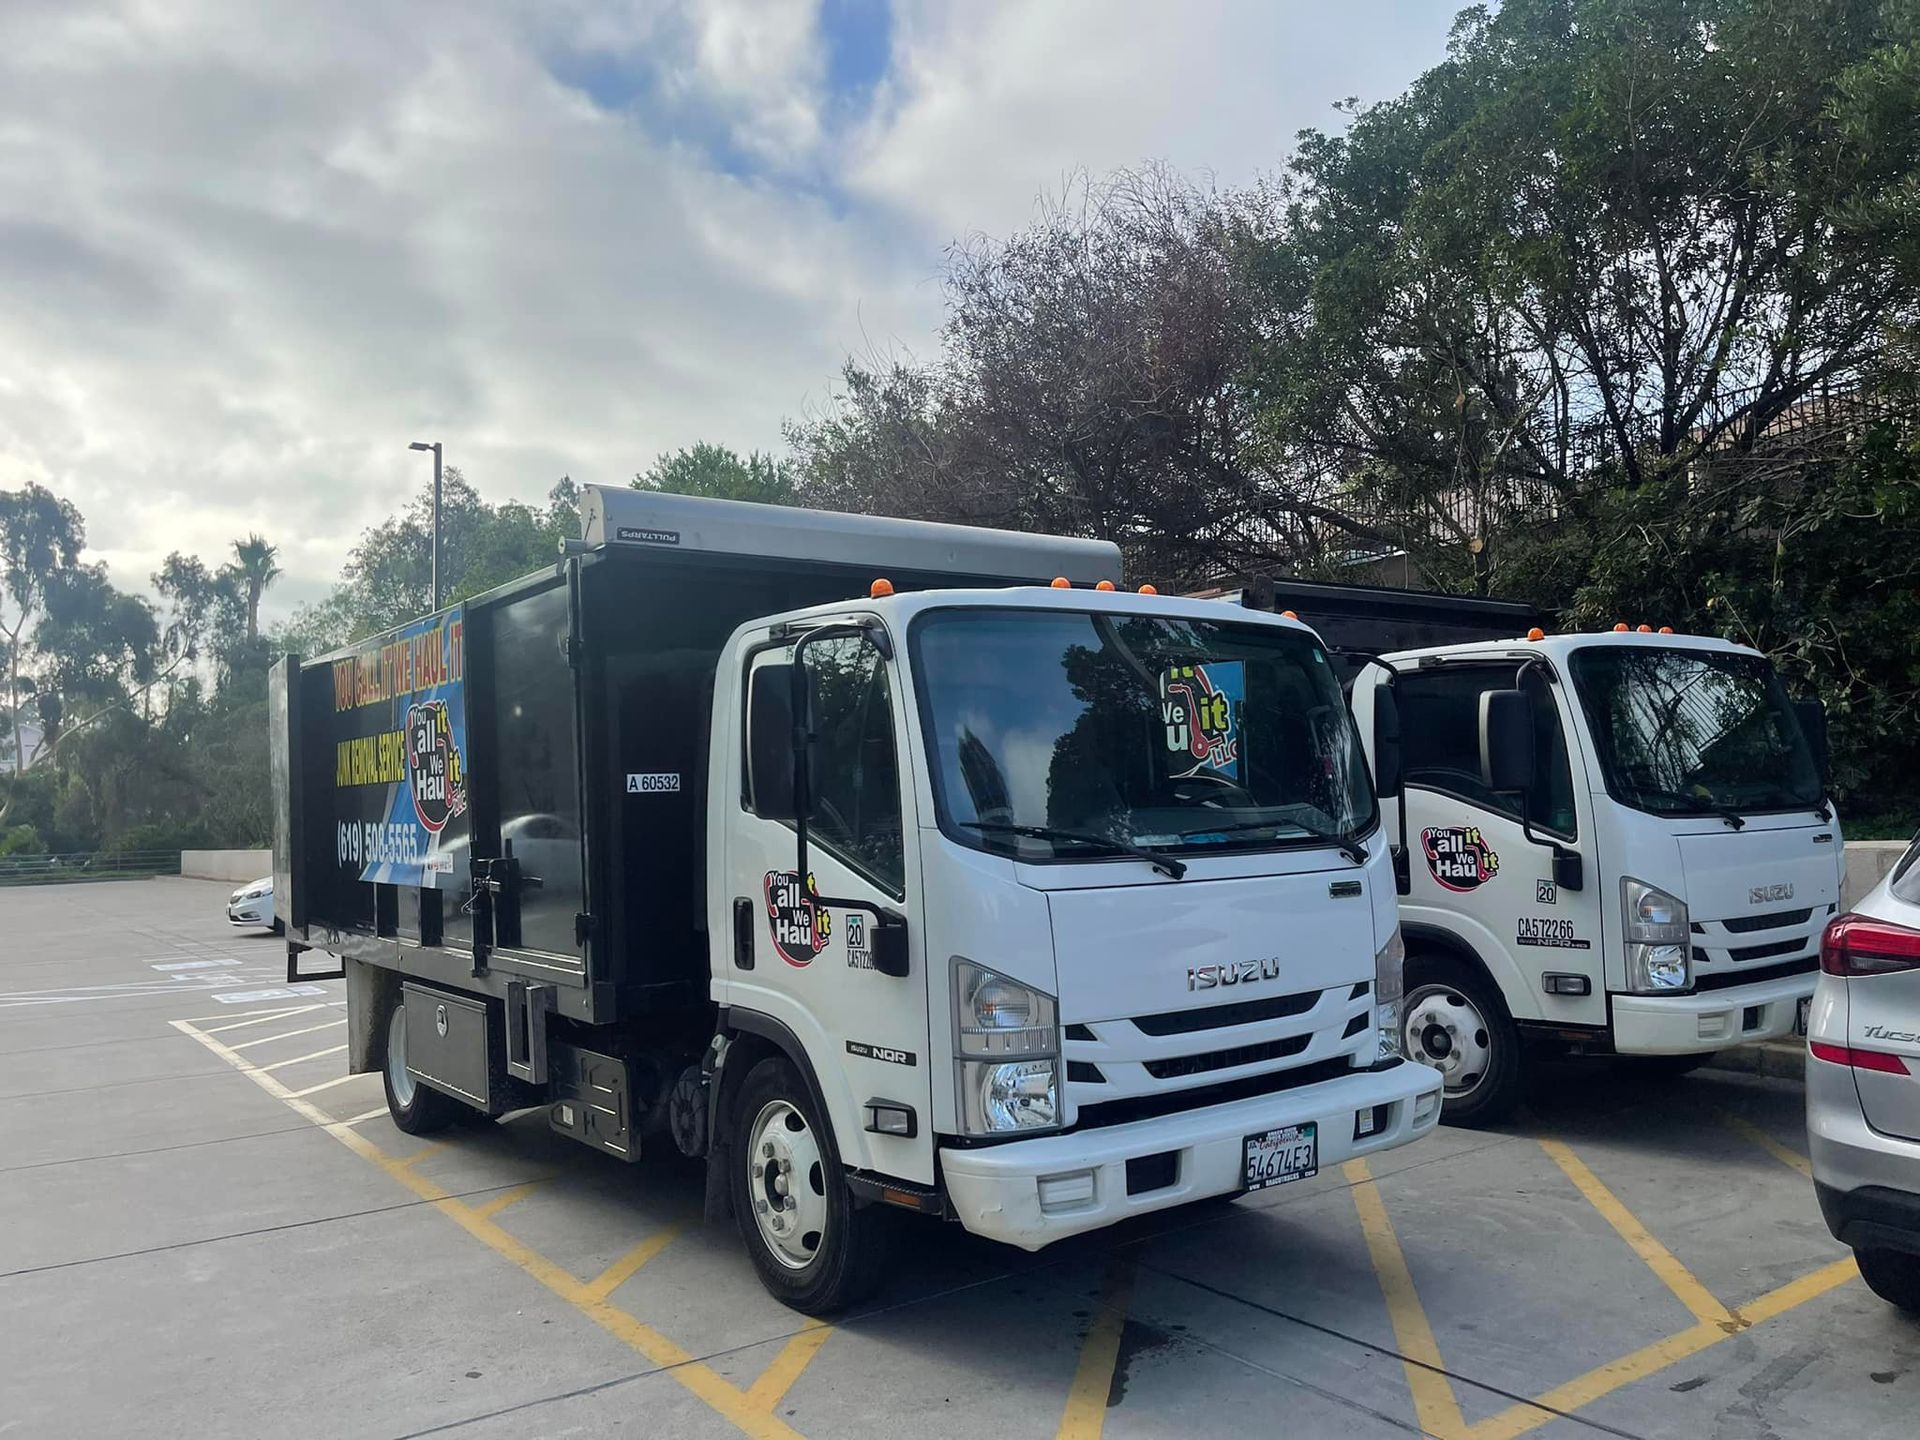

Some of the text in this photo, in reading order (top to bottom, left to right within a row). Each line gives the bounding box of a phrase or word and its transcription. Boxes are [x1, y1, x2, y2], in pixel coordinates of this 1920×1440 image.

[621, 530, 676, 542] PULLTARPS
[333, 658, 354, 712] YOU
[393, 640, 413, 697] WE
[412, 626, 448, 692] HAUL
[449, 620, 463, 684] IT
[412, 709, 427, 726] You
[1201, 696, 1226, 730] it
[430, 753, 444, 776] We
[629, 775, 679, 791] A 60532
[1430, 828, 1450, 838] You
[1465, 827, 1480, 844] it
[337, 819, 418, 870] (619) 508-5565
[1455, 853, 1475, 864] We
[1483, 852, 1499, 869] it
[771, 872, 789, 886] You
[1539, 886, 1554, 902] 20
[1749, 882, 1794, 904] ISUZU
[792, 909, 810, 926] We
[816, 909, 831, 935] it
[848, 924, 862, 946] 20
[1518, 918, 1574, 939] CA572266
[1187, 957, 1280, 992] ISUZU
[872, 1047, 907, 1064] NQR
[1247, 1144, 1312, 1181] 54674E3
